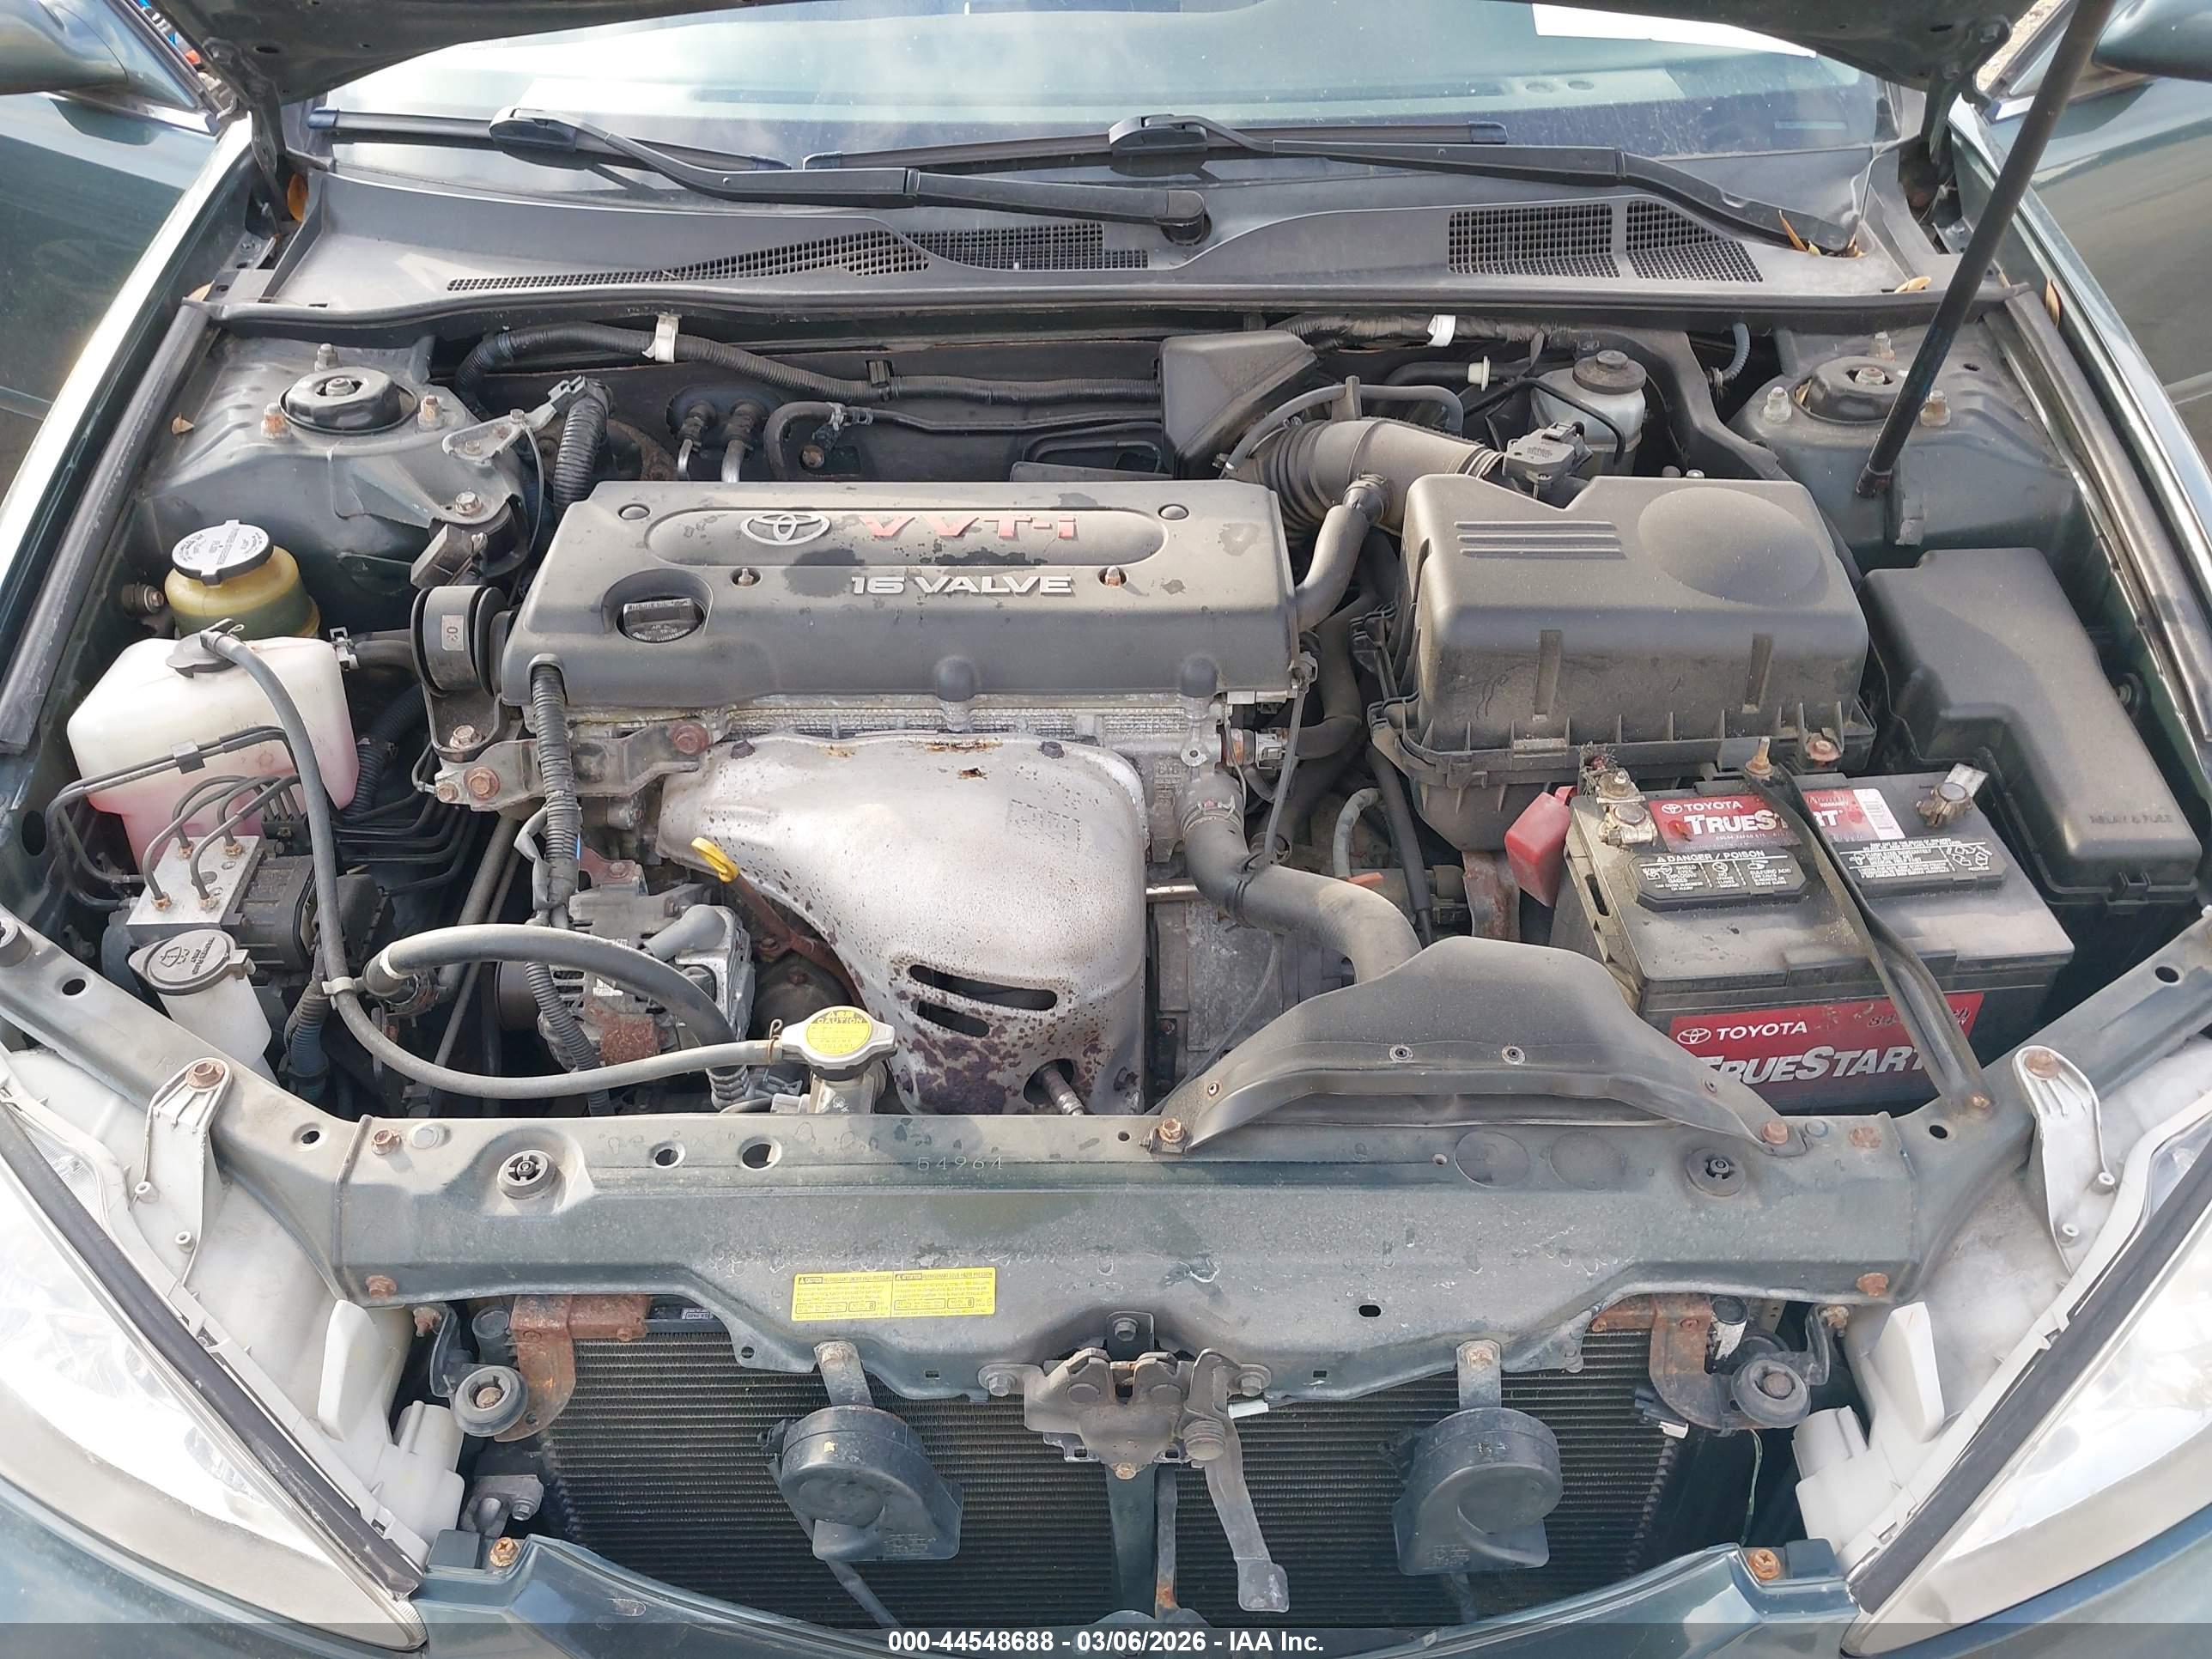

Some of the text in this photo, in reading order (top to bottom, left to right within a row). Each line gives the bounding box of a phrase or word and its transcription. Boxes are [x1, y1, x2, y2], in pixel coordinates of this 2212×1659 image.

[859, 516, 1077, 539] VVT-i
[852, 576, 1073, 595] 16 VALVE
[1684, 800, 1743, 811] TOYOTA
[1668, 854, 1713, 862] DANGER
[1723, 850, 1765, 859] POISON
[1717, 1021, 1808, 1041] TOYOTA
[918, 1154, 1003, 1171] 54964
